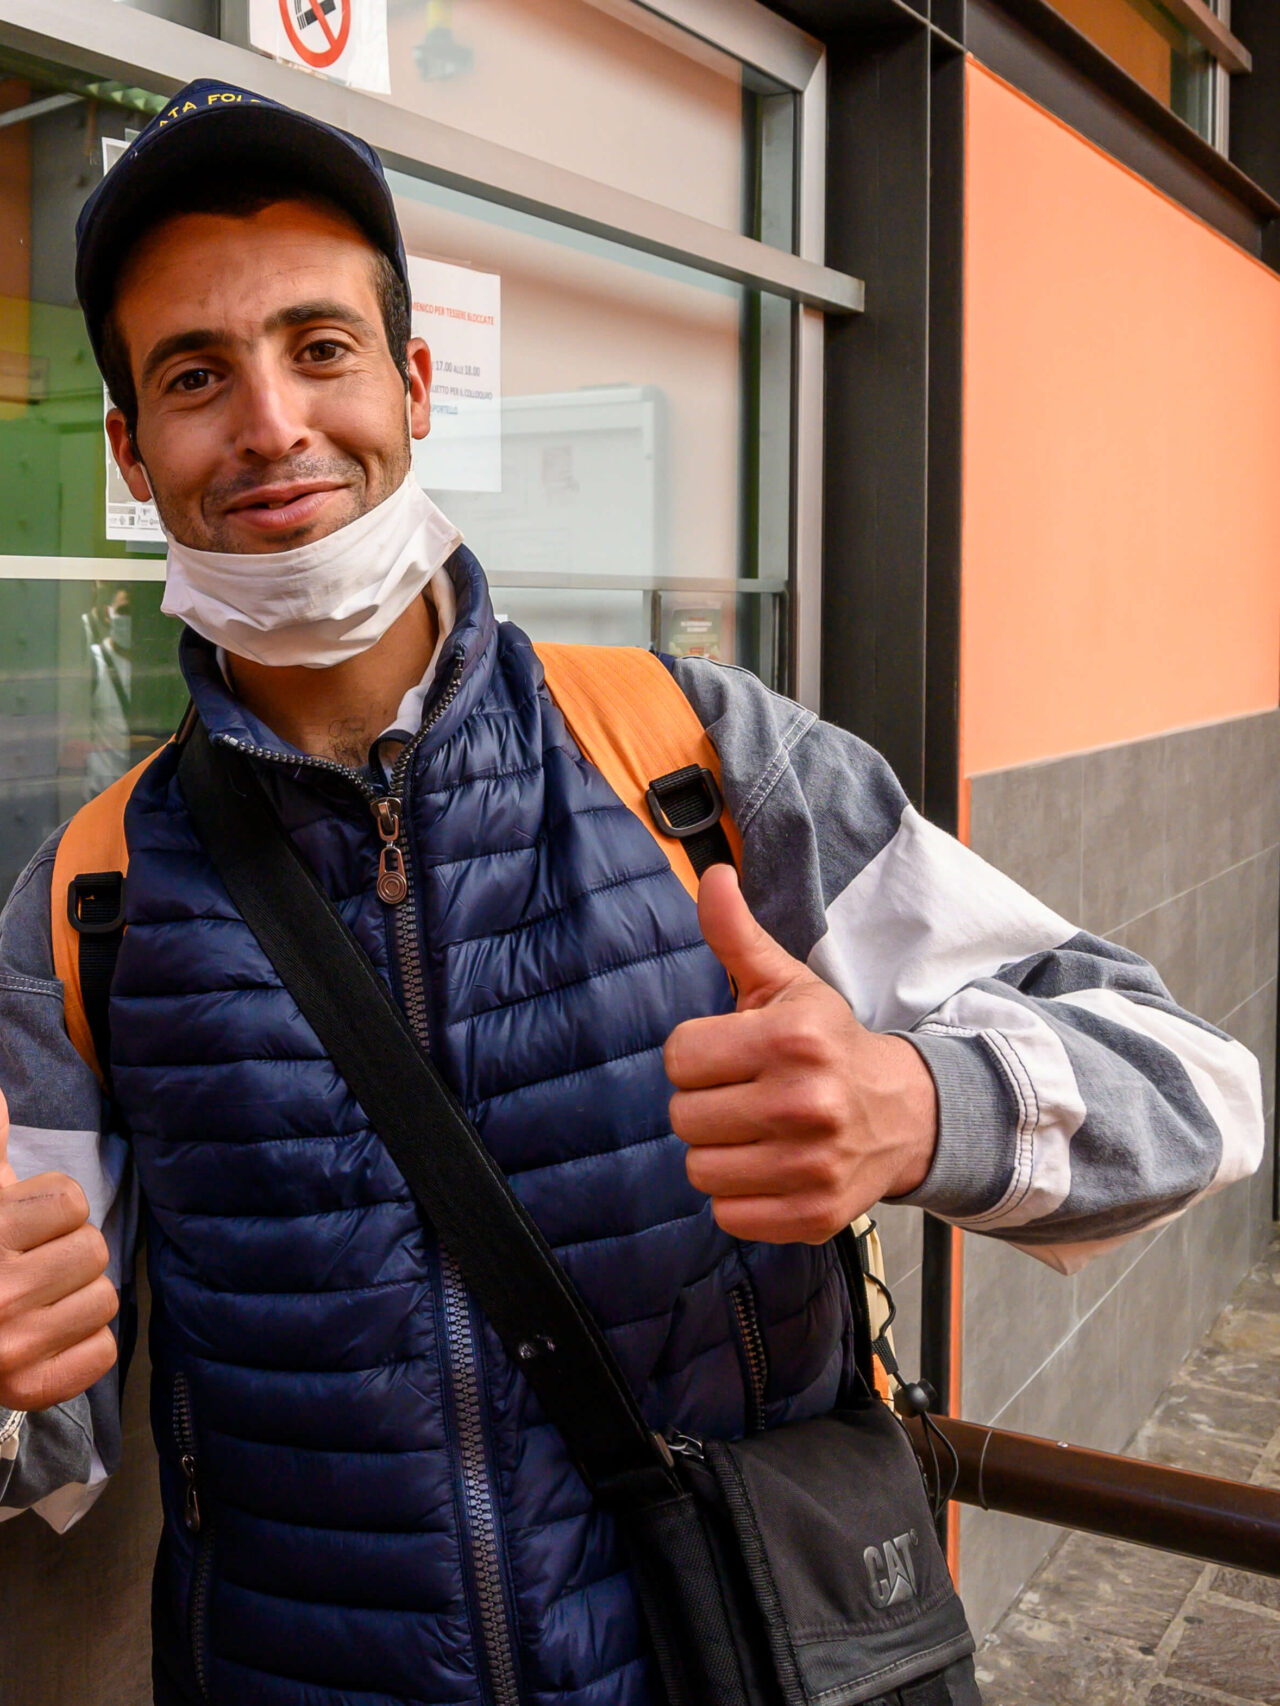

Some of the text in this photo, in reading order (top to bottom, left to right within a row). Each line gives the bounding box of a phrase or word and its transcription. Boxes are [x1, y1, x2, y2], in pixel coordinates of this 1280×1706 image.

[435, 305, 445, 316] PER
[436, 360, 452, 372] 17.00
[863, 1532, 918, 1609] CAT
